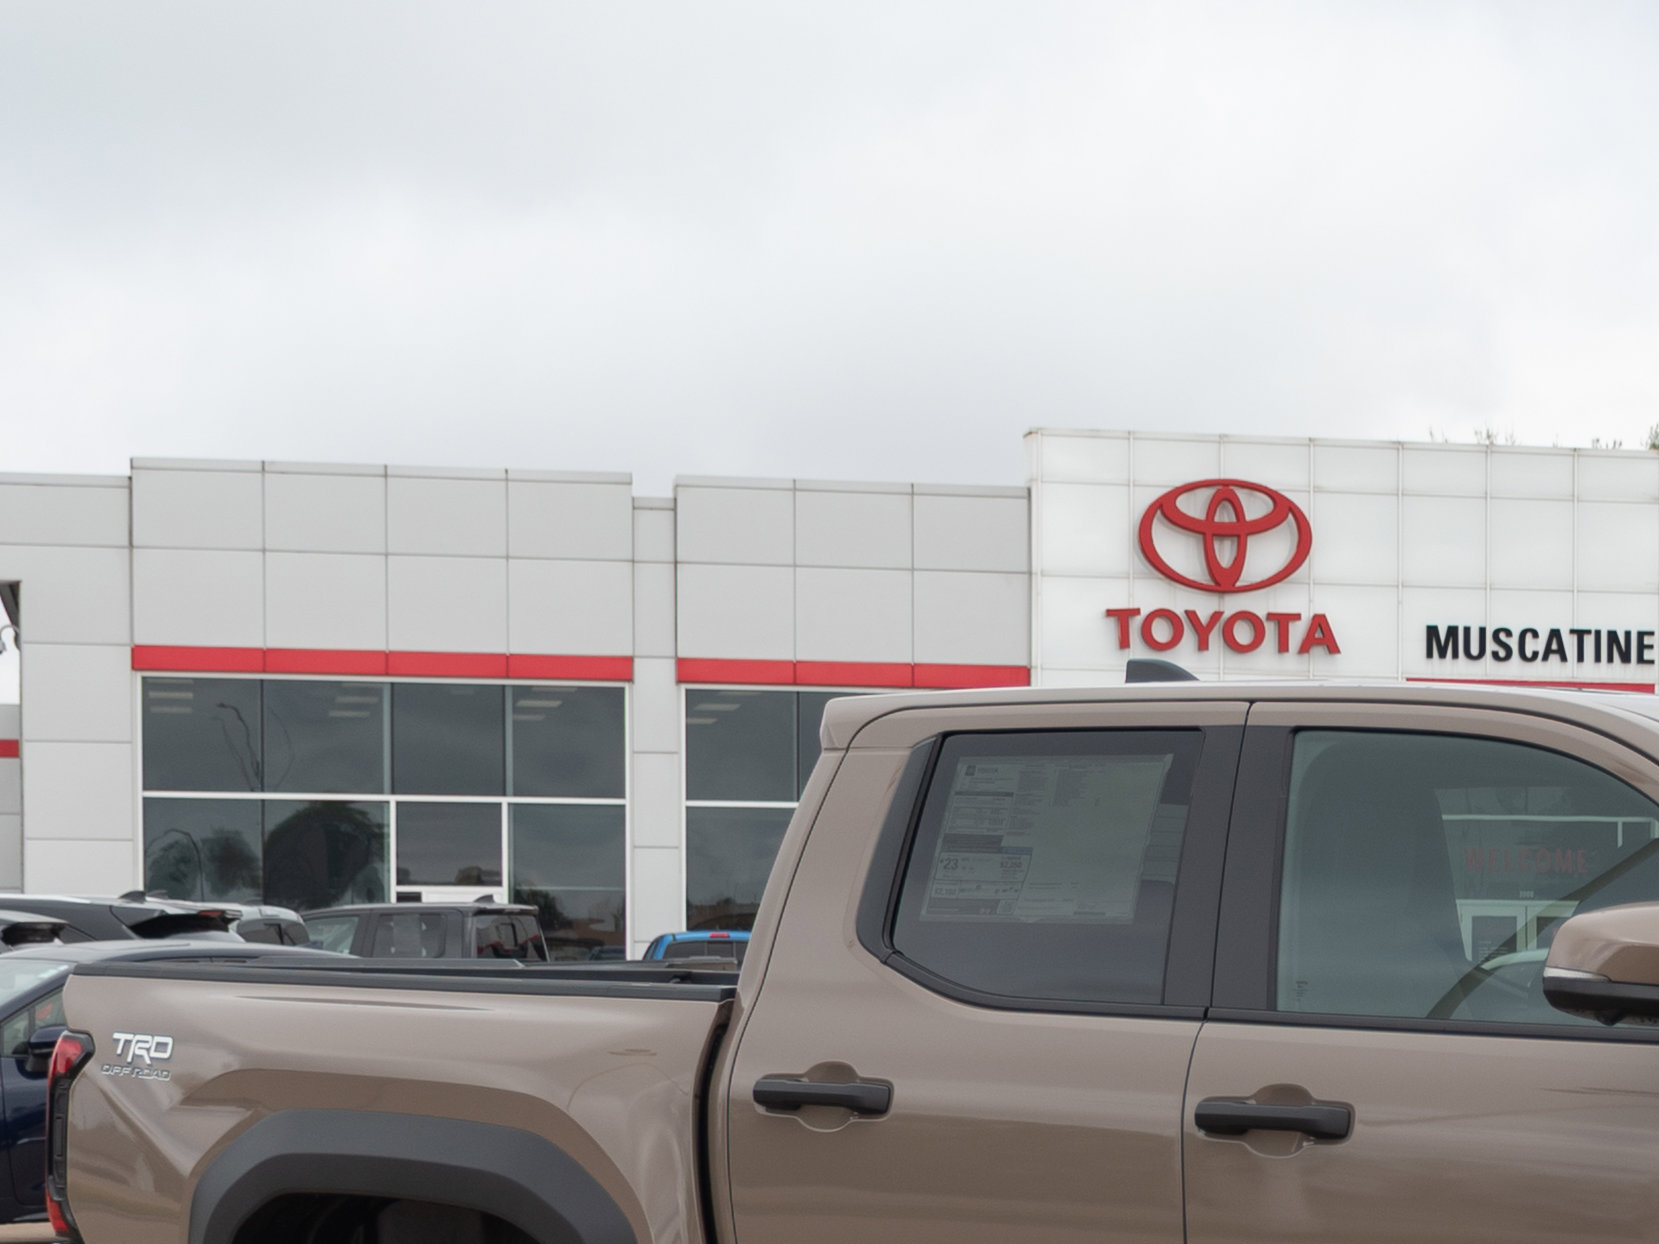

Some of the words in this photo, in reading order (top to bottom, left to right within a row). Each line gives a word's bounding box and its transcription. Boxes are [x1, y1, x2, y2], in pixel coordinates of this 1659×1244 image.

[1106, 608, 1341, 655] TOYOTA
[1425, 625, 1656, 665] MUSCATINE
[1464, 848, 1588, 873] WELCOME
[113, 1032, 174, 1064] TRD
[102, 1065, 131, 1077] OFF
[131, 1066, 172, 1081] ROAD
